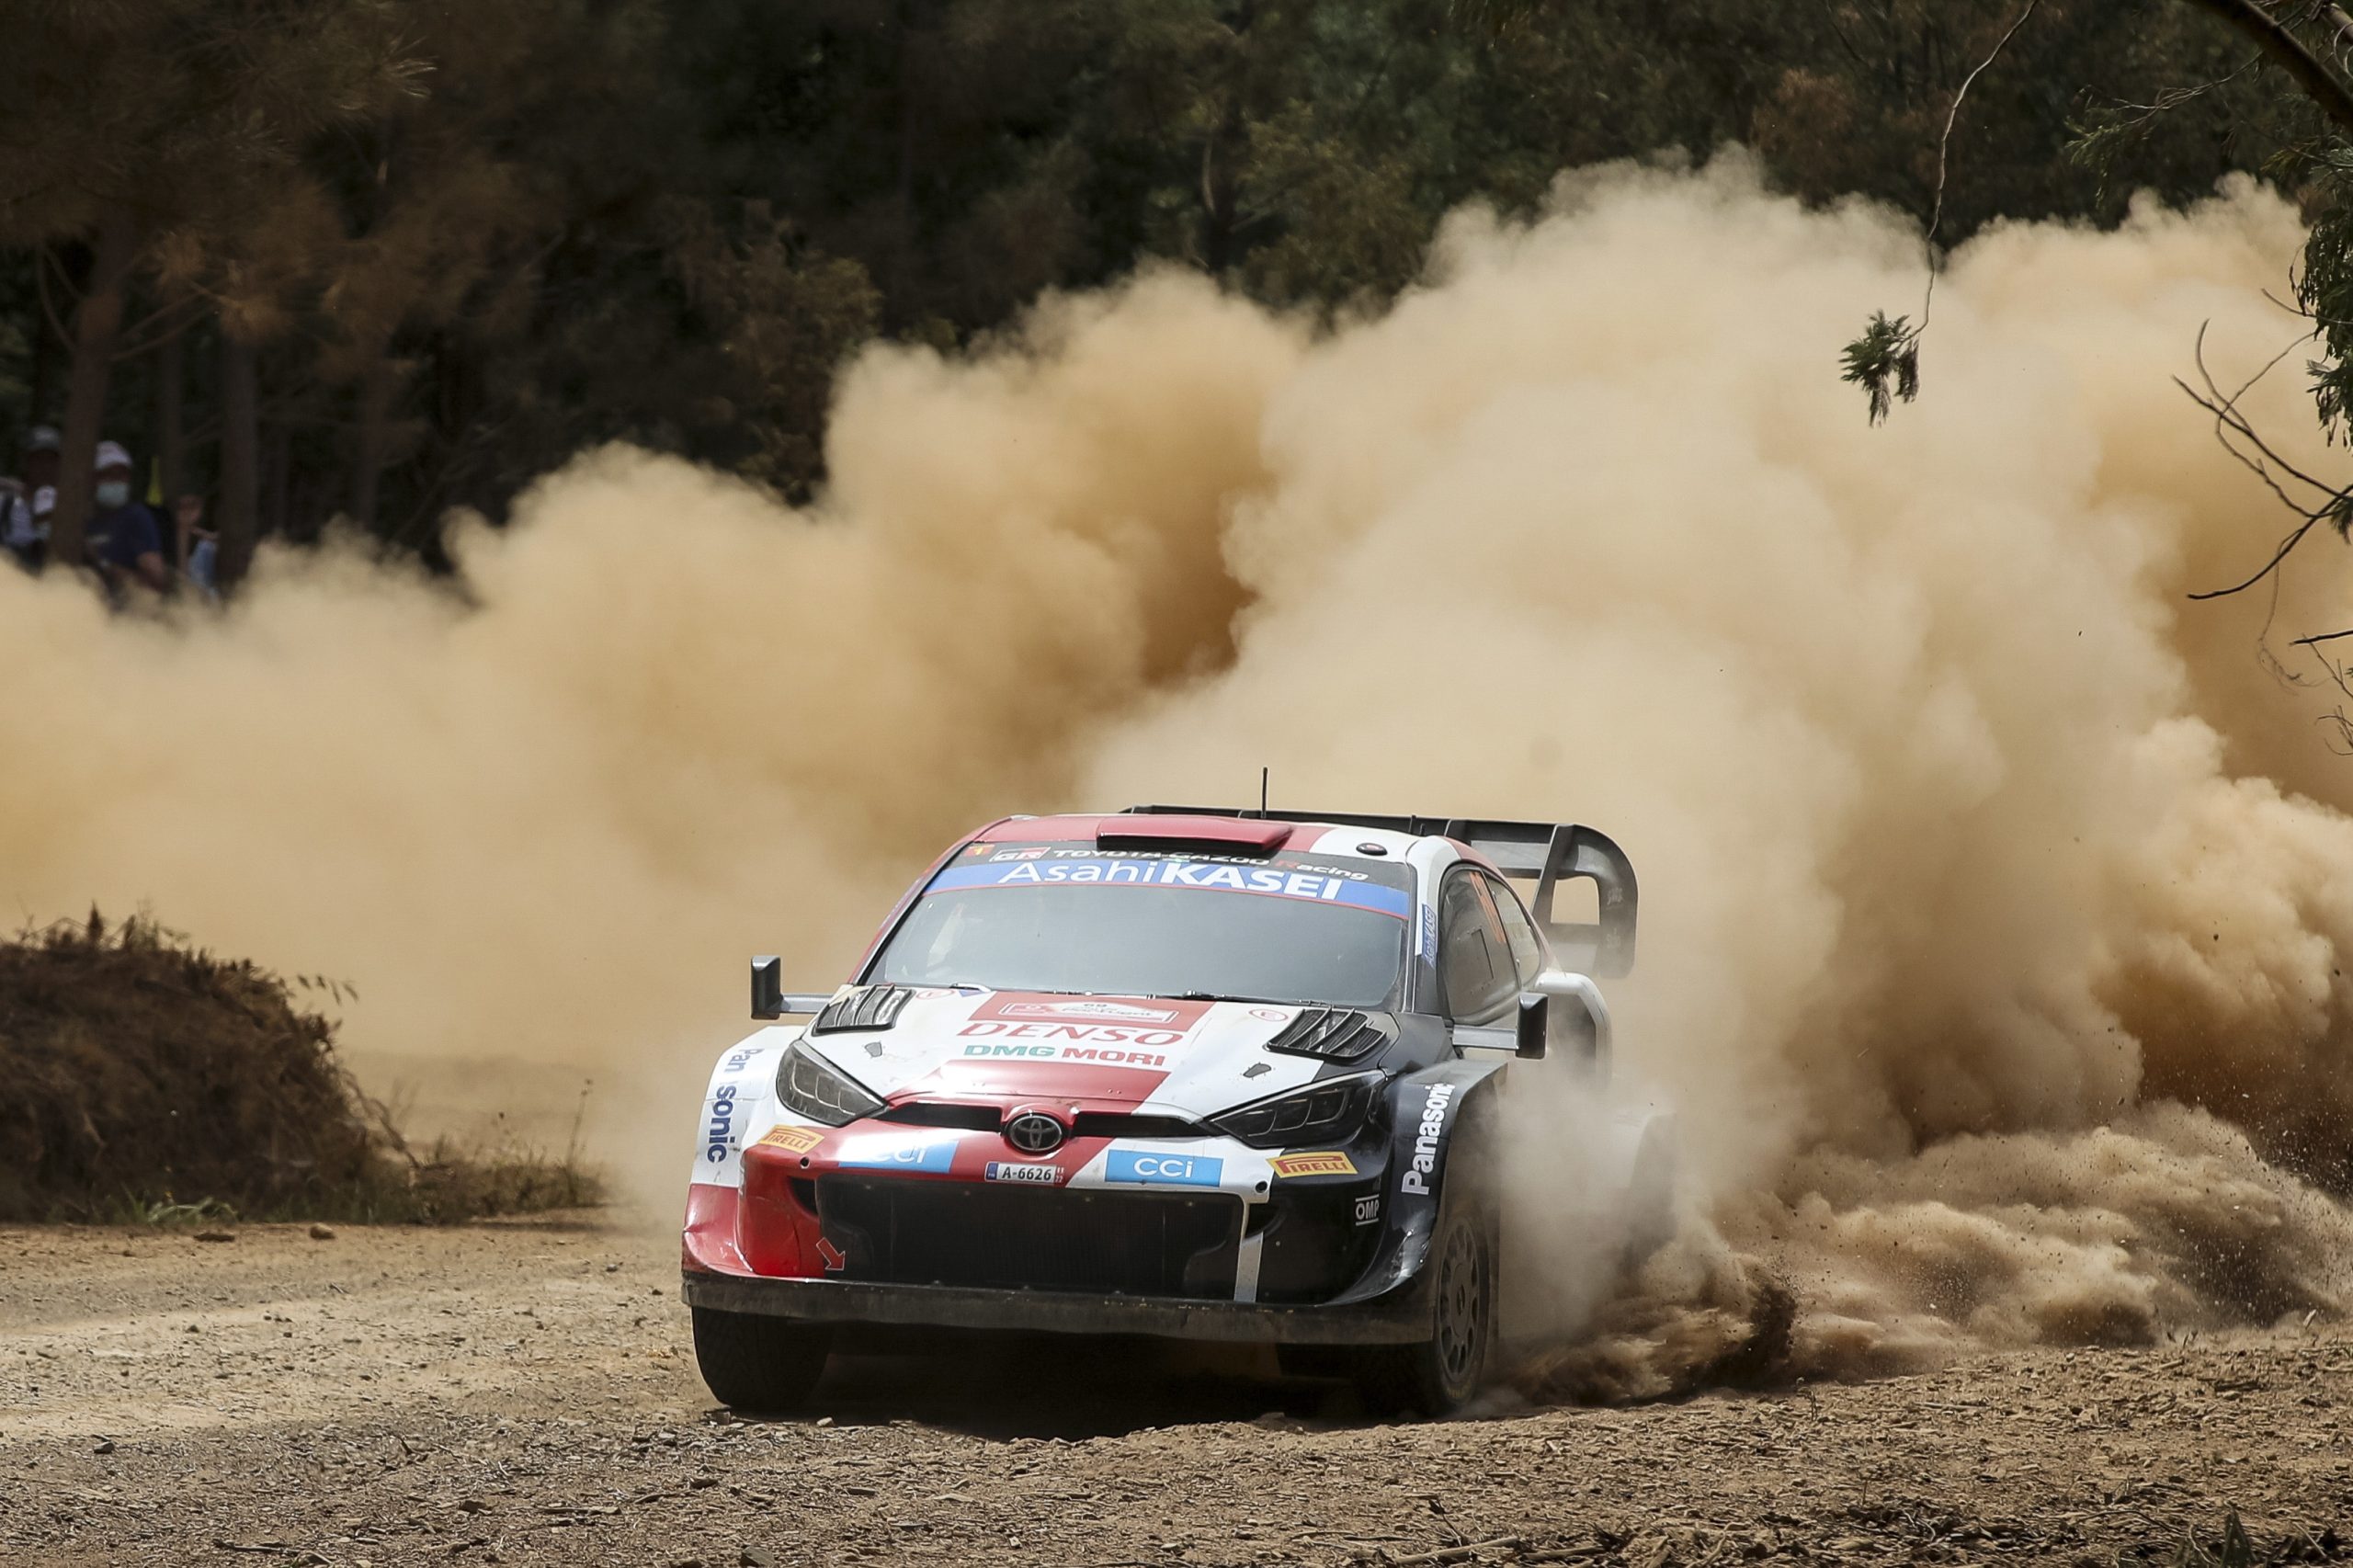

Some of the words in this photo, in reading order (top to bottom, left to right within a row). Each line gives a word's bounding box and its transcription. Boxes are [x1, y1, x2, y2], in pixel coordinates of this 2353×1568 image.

[1274, 859, 1369, 881] Racing
[957, 1022, 1183, 1045] DENSO
[963, 1045, 1056, 1057] DMG
[1062, 1047, 1165, 1066] MORI
[707, 1048, 765, 1163] Pansonic
[1002, 1166, 1051, 1181] A-6626
[1275, 1155, 1348, 1174] PIRELLI
[1356, 1199, 1379, 1220] OMP
